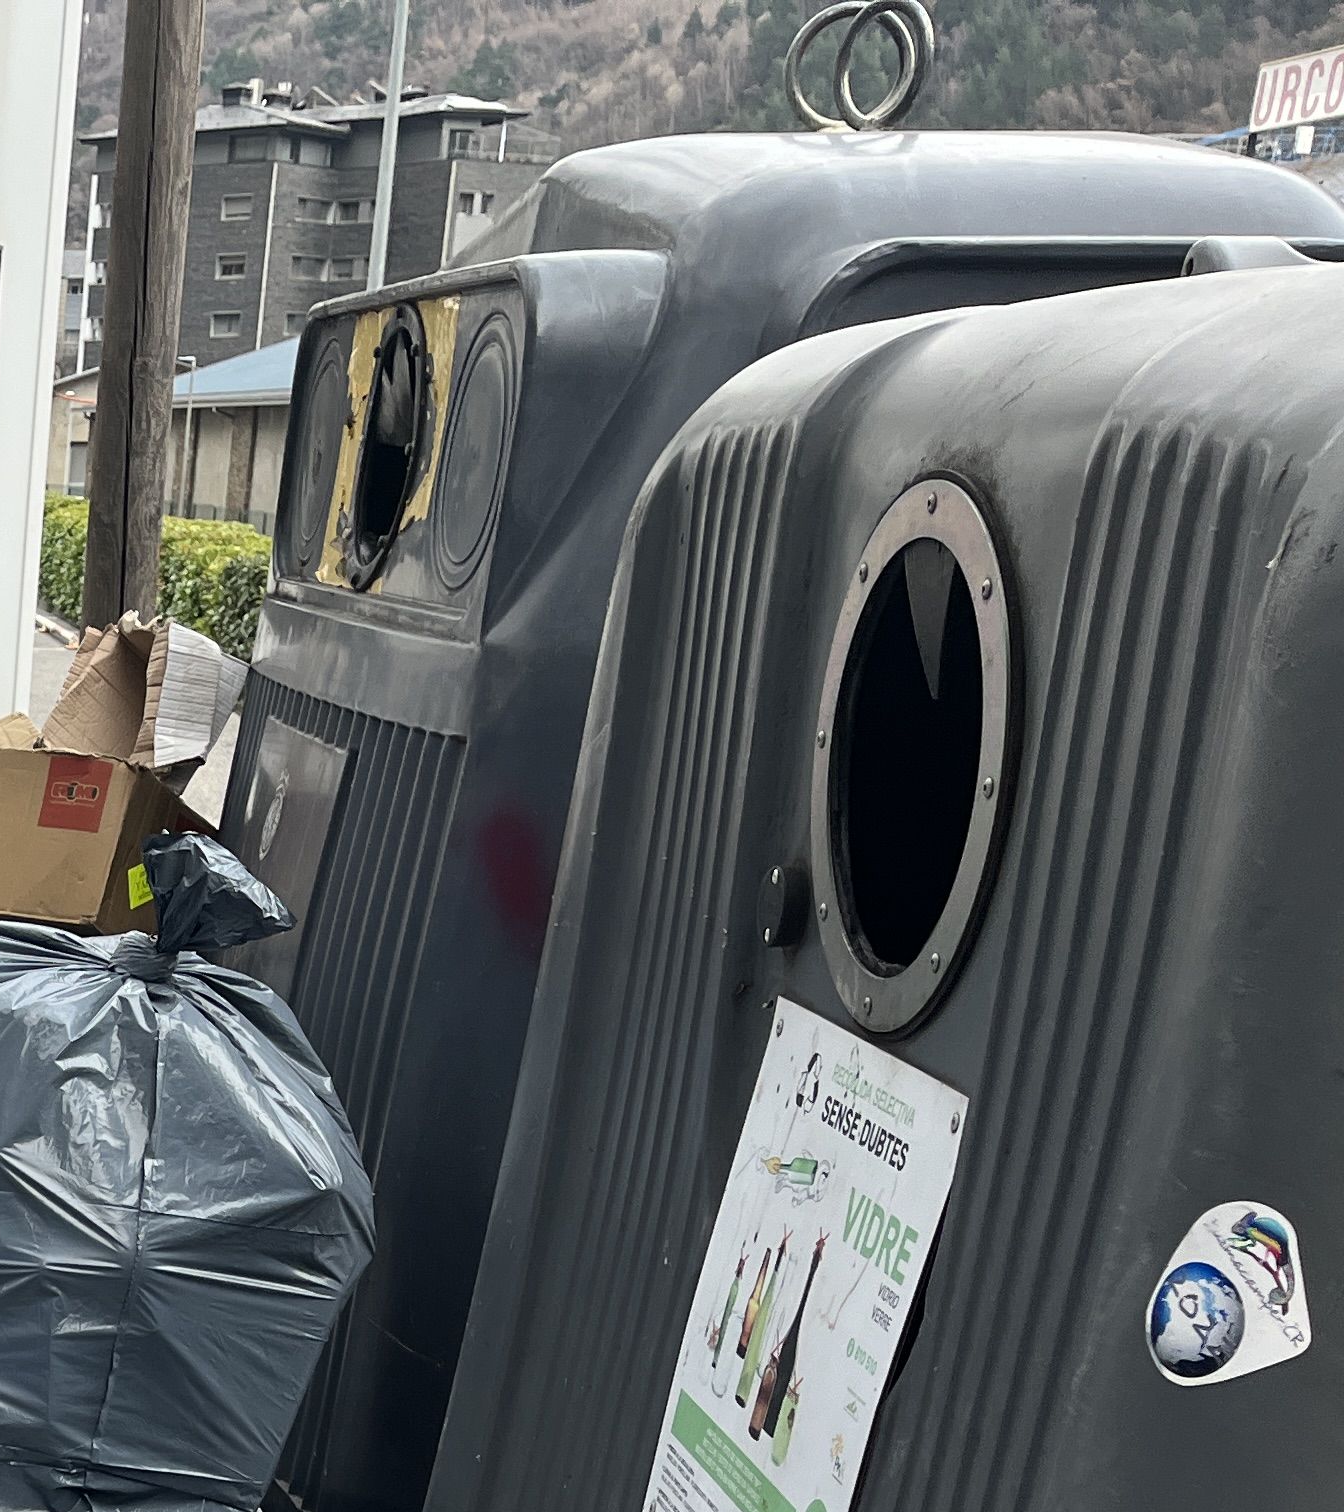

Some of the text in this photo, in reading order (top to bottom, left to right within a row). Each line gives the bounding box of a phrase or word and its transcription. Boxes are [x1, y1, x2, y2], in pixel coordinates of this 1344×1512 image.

[822, 1096, 909, 1171] SENSE DUBTES
[842, 1186, 919, 1286] VIDRE
[871, 1304, 893, 1332] VERRE
